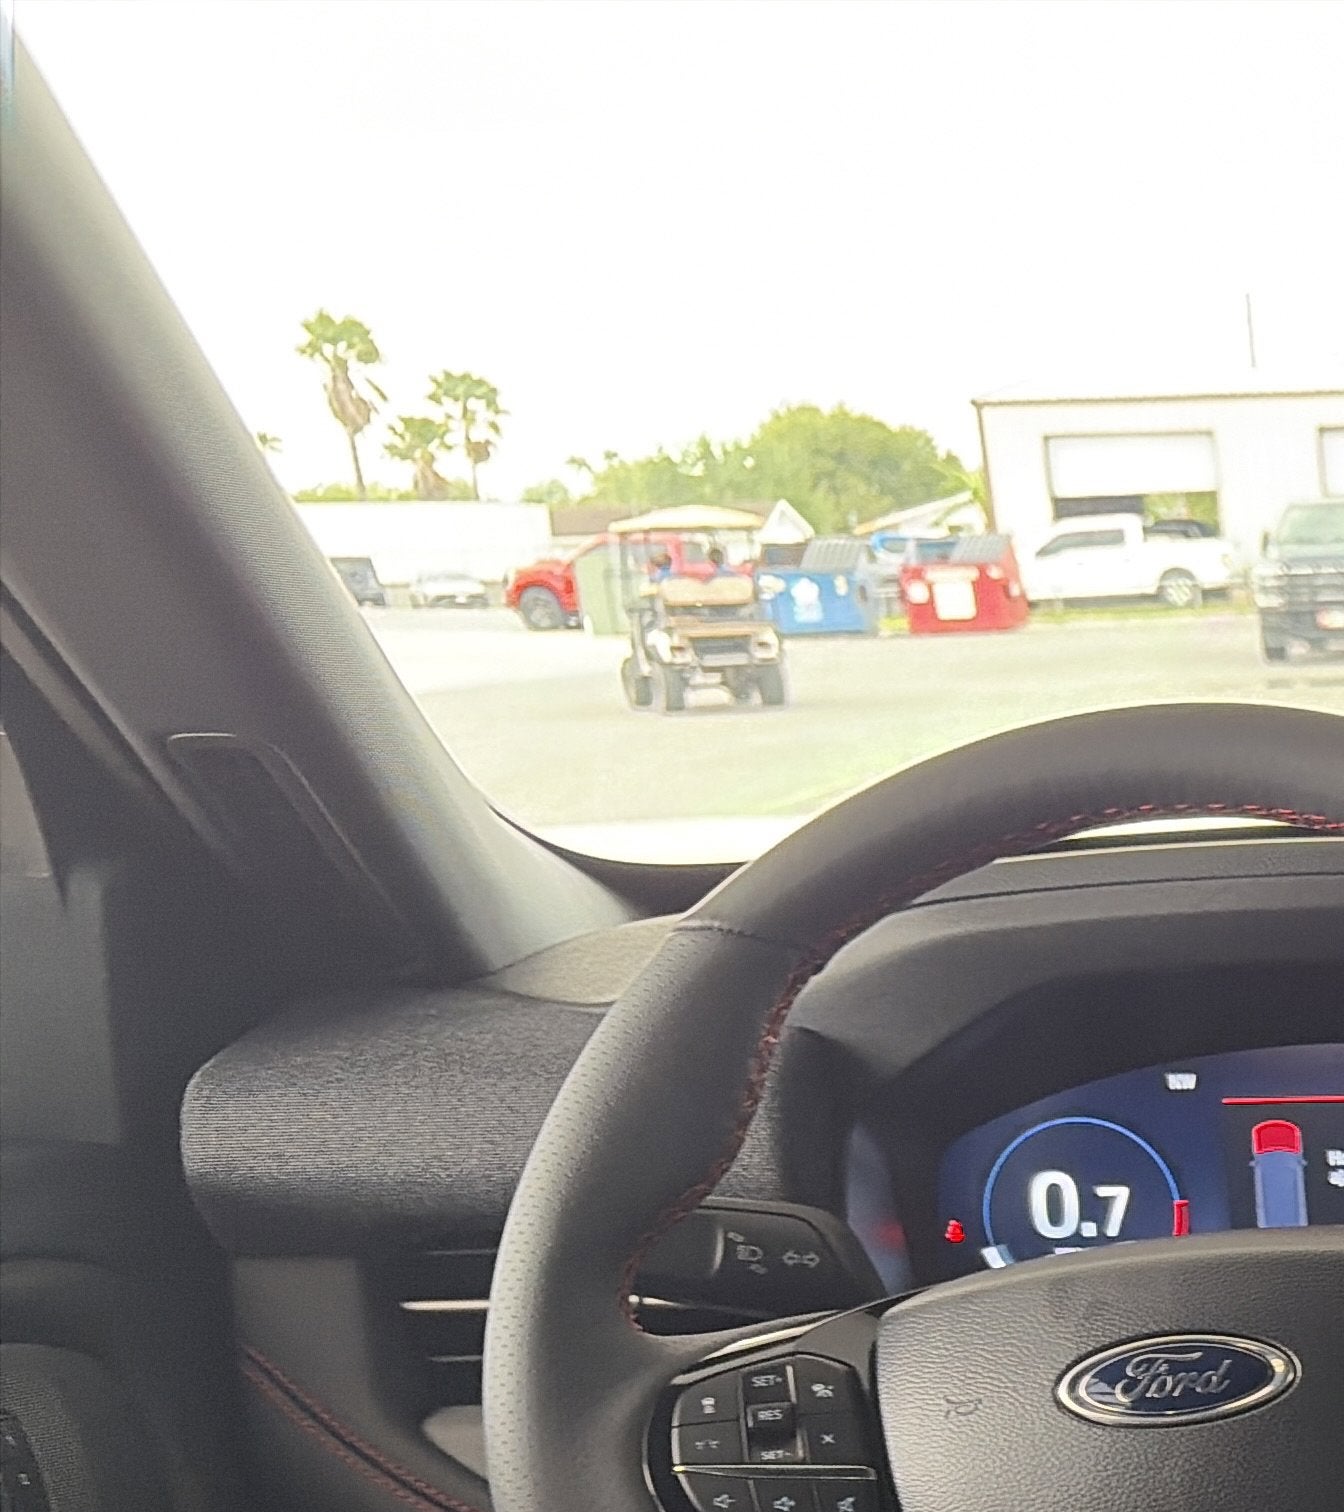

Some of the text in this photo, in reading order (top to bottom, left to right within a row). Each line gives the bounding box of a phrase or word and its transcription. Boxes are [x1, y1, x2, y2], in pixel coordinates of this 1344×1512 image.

[1028, 1170, 1131, 1239] 0.7
[752, 1374, 783, 1387] SET+
[1114, 1351, 1233, 1403] Ford
[757, 1409, 783, 1421] RES
